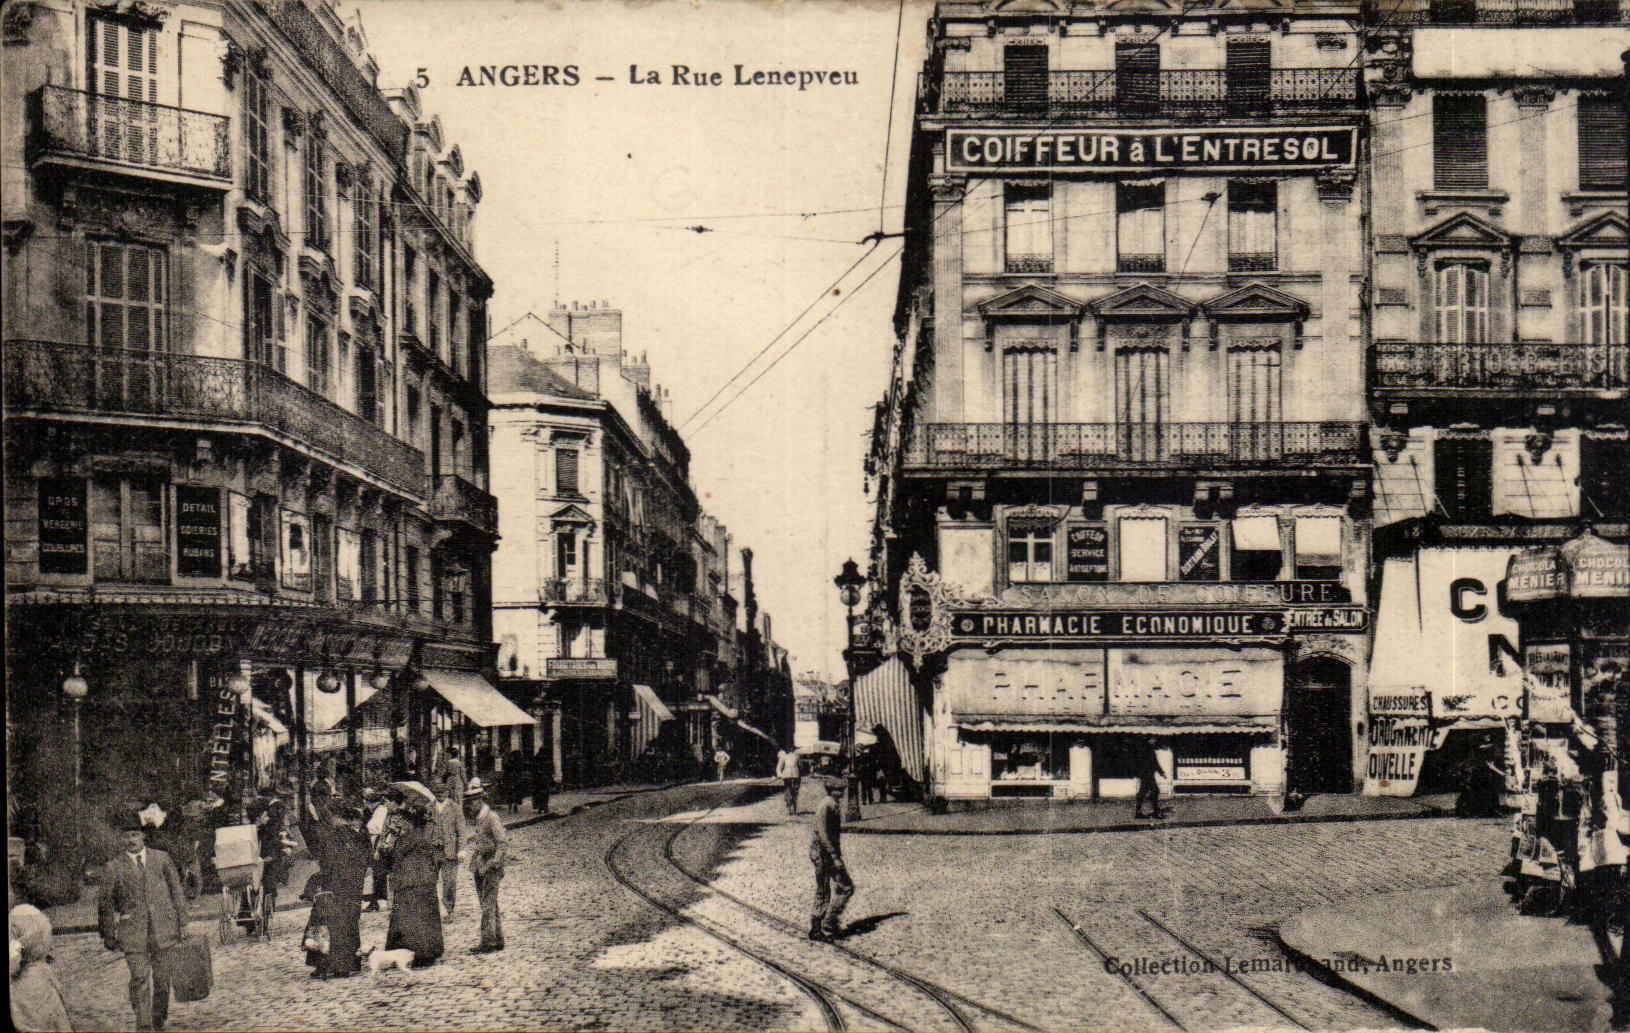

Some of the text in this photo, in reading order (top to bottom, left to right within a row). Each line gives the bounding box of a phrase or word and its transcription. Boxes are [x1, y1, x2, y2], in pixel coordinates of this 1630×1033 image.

[961, 135, 1120, 163] COIFFEUR
[1155, 133, 1339, 162] L'ENTRESOL
[182, 502, 217, 513] DETAIL
[1071, 548, 1105, 558] SERVICE
[1508, 572, 1565, 590] MENIER
[1021, 583, 1335, 603] SALON DE COIFFURE
[982, 614, 1254, 635] PHARMACIE ECONOMIQUE
[1333, 608, 1364, 627] SALON
[992, 669, 1243, 700] PHARMACIE
[1372, 694, 1428, 712] CHAUSSURES
